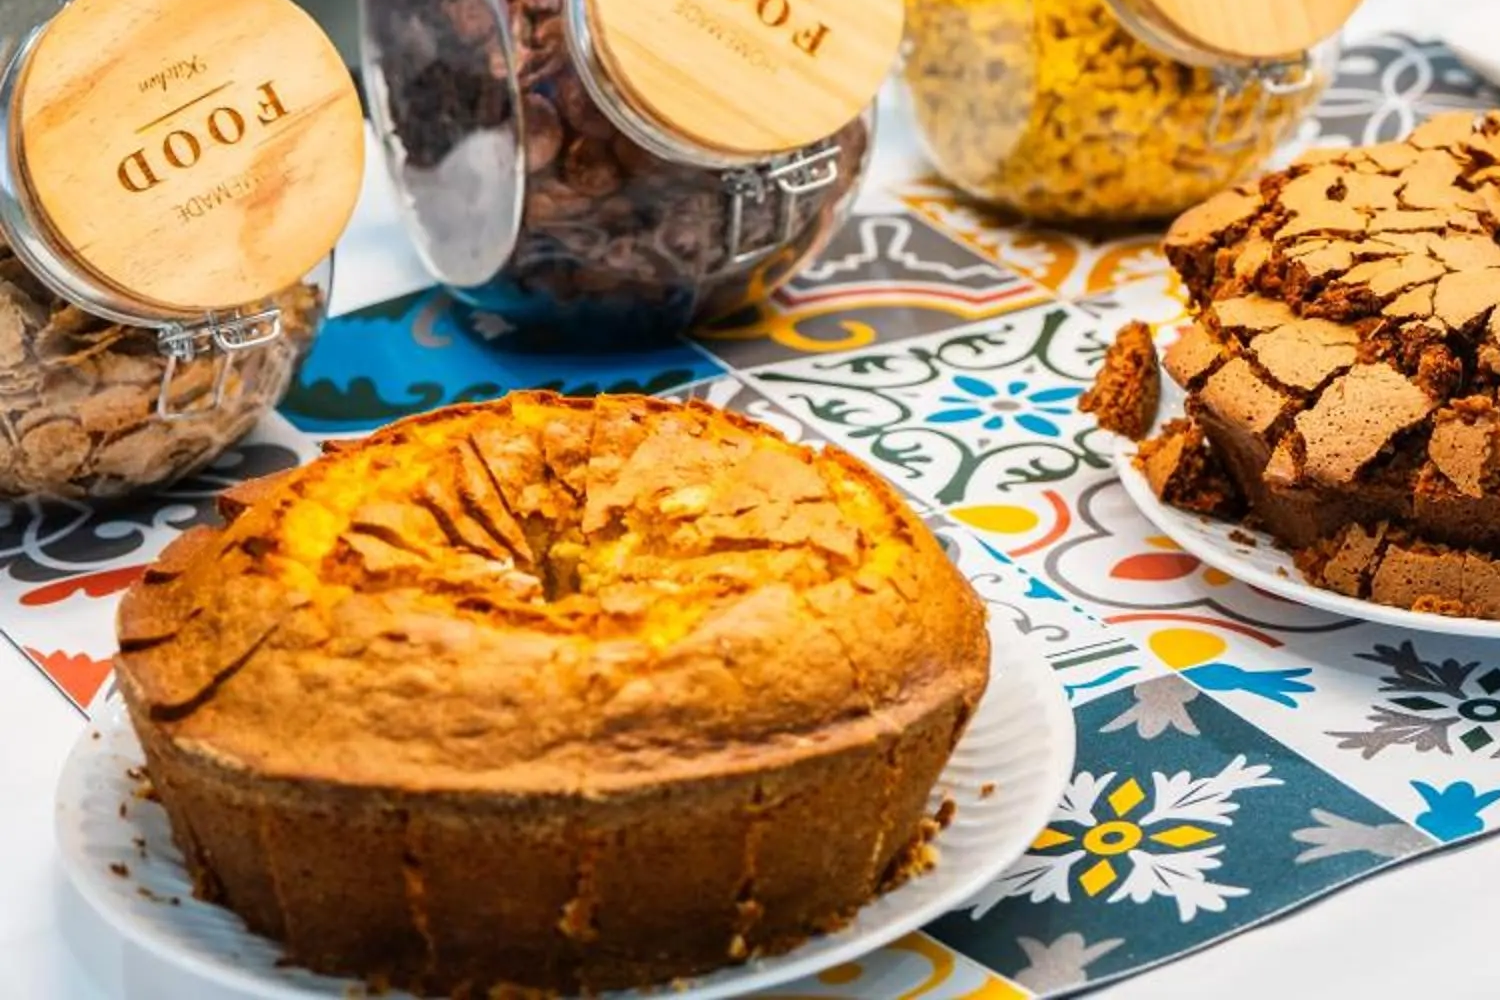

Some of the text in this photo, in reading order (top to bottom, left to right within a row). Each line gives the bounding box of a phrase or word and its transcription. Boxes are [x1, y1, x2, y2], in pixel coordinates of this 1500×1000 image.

[138, 55, 208, 94] Kitchen
[116, 79, 290, 194] FOOD
[172, 164, 278, 225] MEMADE
